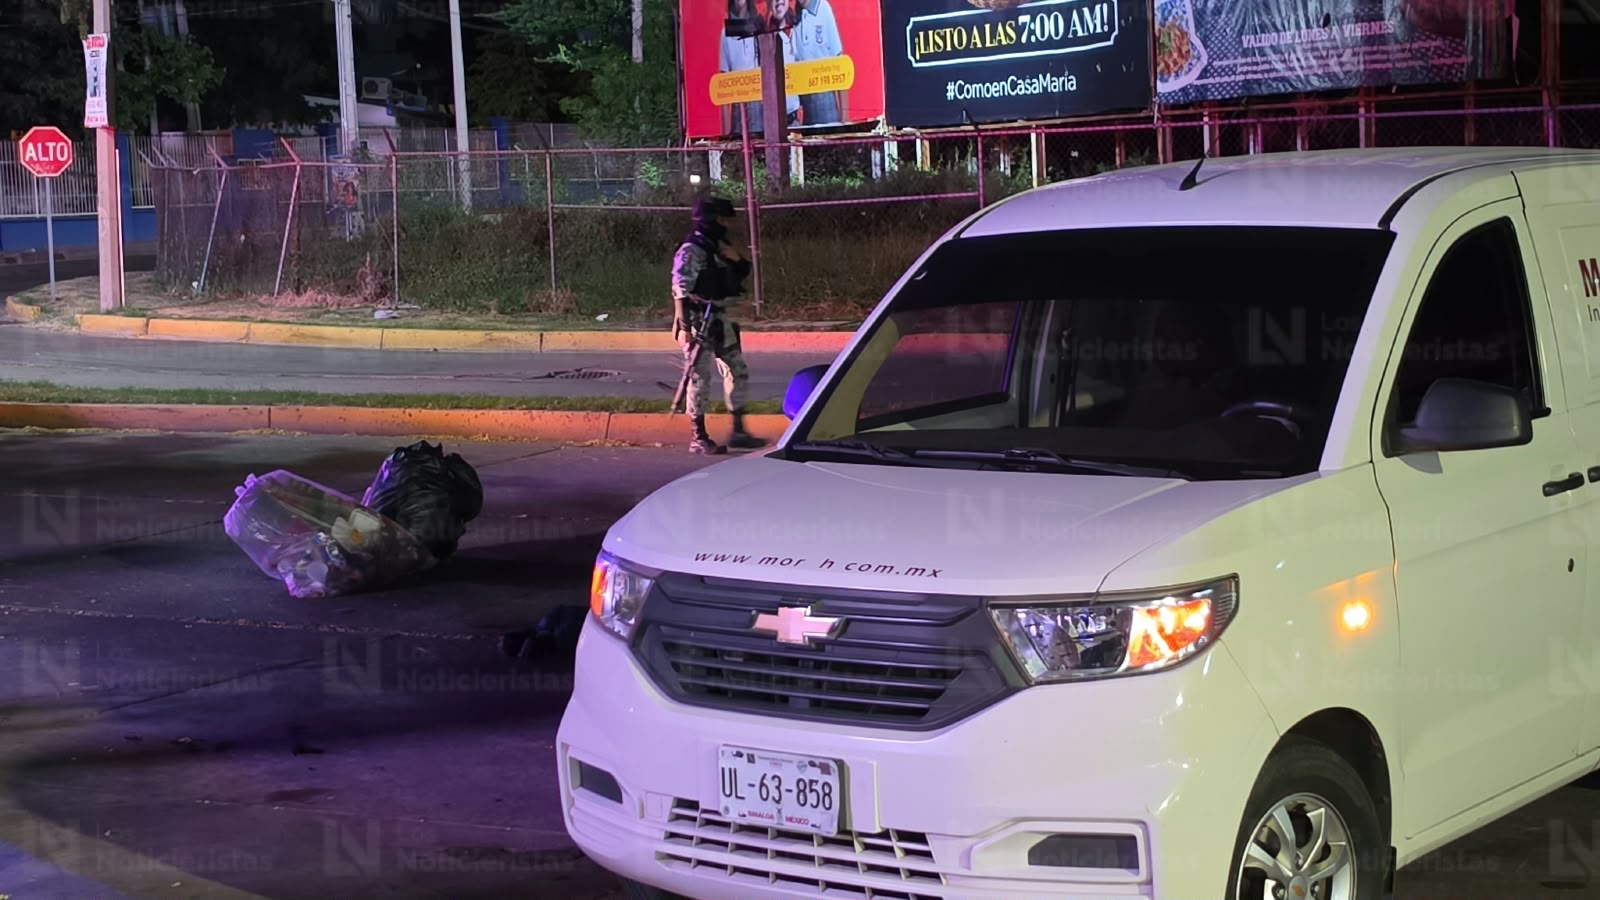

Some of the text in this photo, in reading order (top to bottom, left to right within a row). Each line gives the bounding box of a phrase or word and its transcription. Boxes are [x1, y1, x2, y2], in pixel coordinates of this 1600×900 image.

[915, 3, 1109, 59] ¡LISTO A LAS 7:00 AM!
[1279, 31, 1293, 44] DE
[1295, 28, 1328, 43] LUNES
[1342, 20, 1395, 38] VIERNES
[25, 141, 69, 162] ALTO
[694, 551, 752, 563] www
[844, 560, 943, 579] com.mx
[721, 767, 833, 811] UL-63-858
